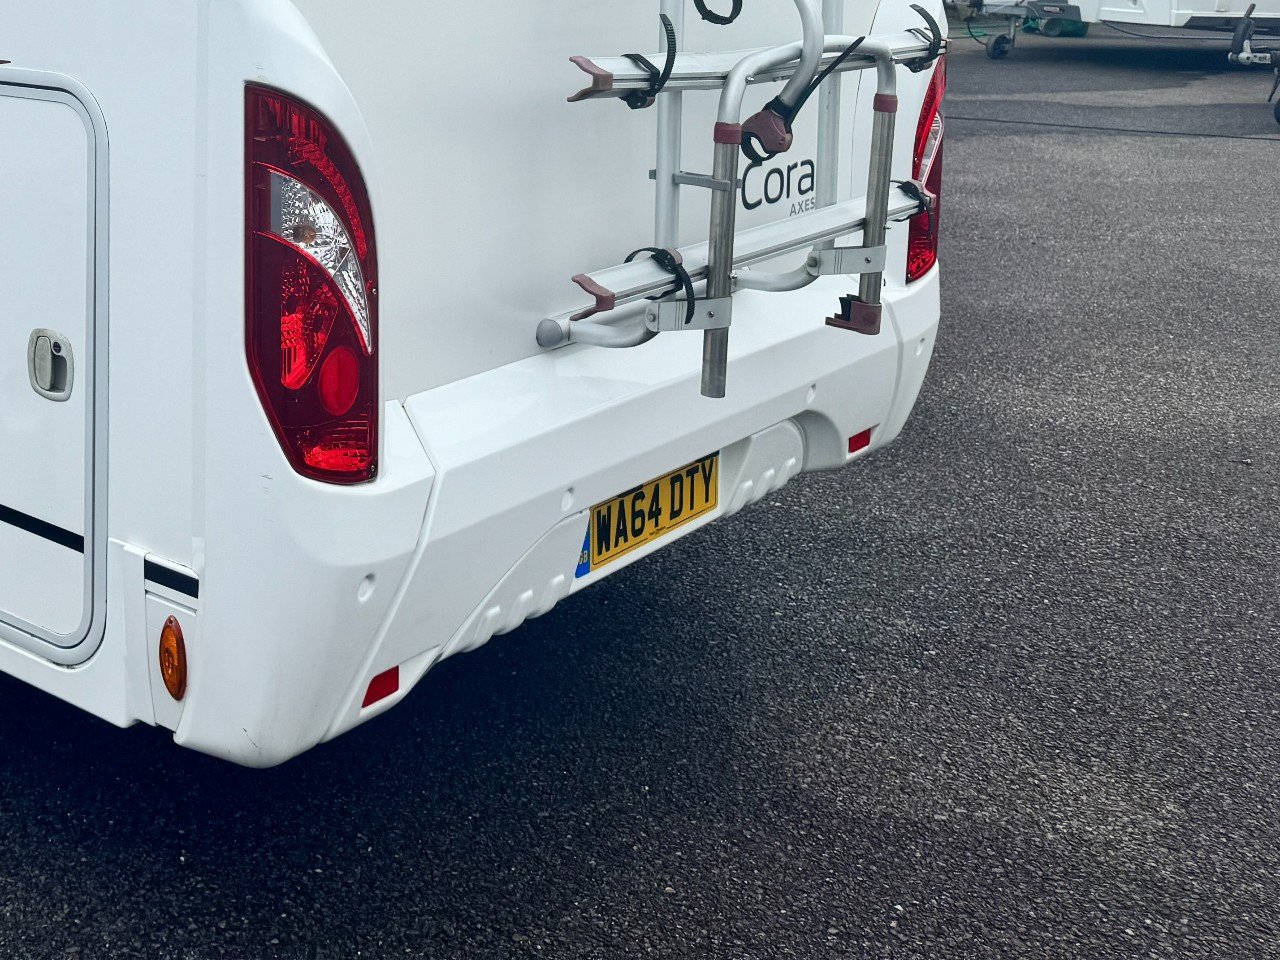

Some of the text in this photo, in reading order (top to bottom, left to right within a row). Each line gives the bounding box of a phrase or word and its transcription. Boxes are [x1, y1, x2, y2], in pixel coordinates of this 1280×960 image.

[741, 158, 815, 211] Cora
[789, 196, 815, 217] AXES
[596, 457, 715, 556] WA64 DTY
